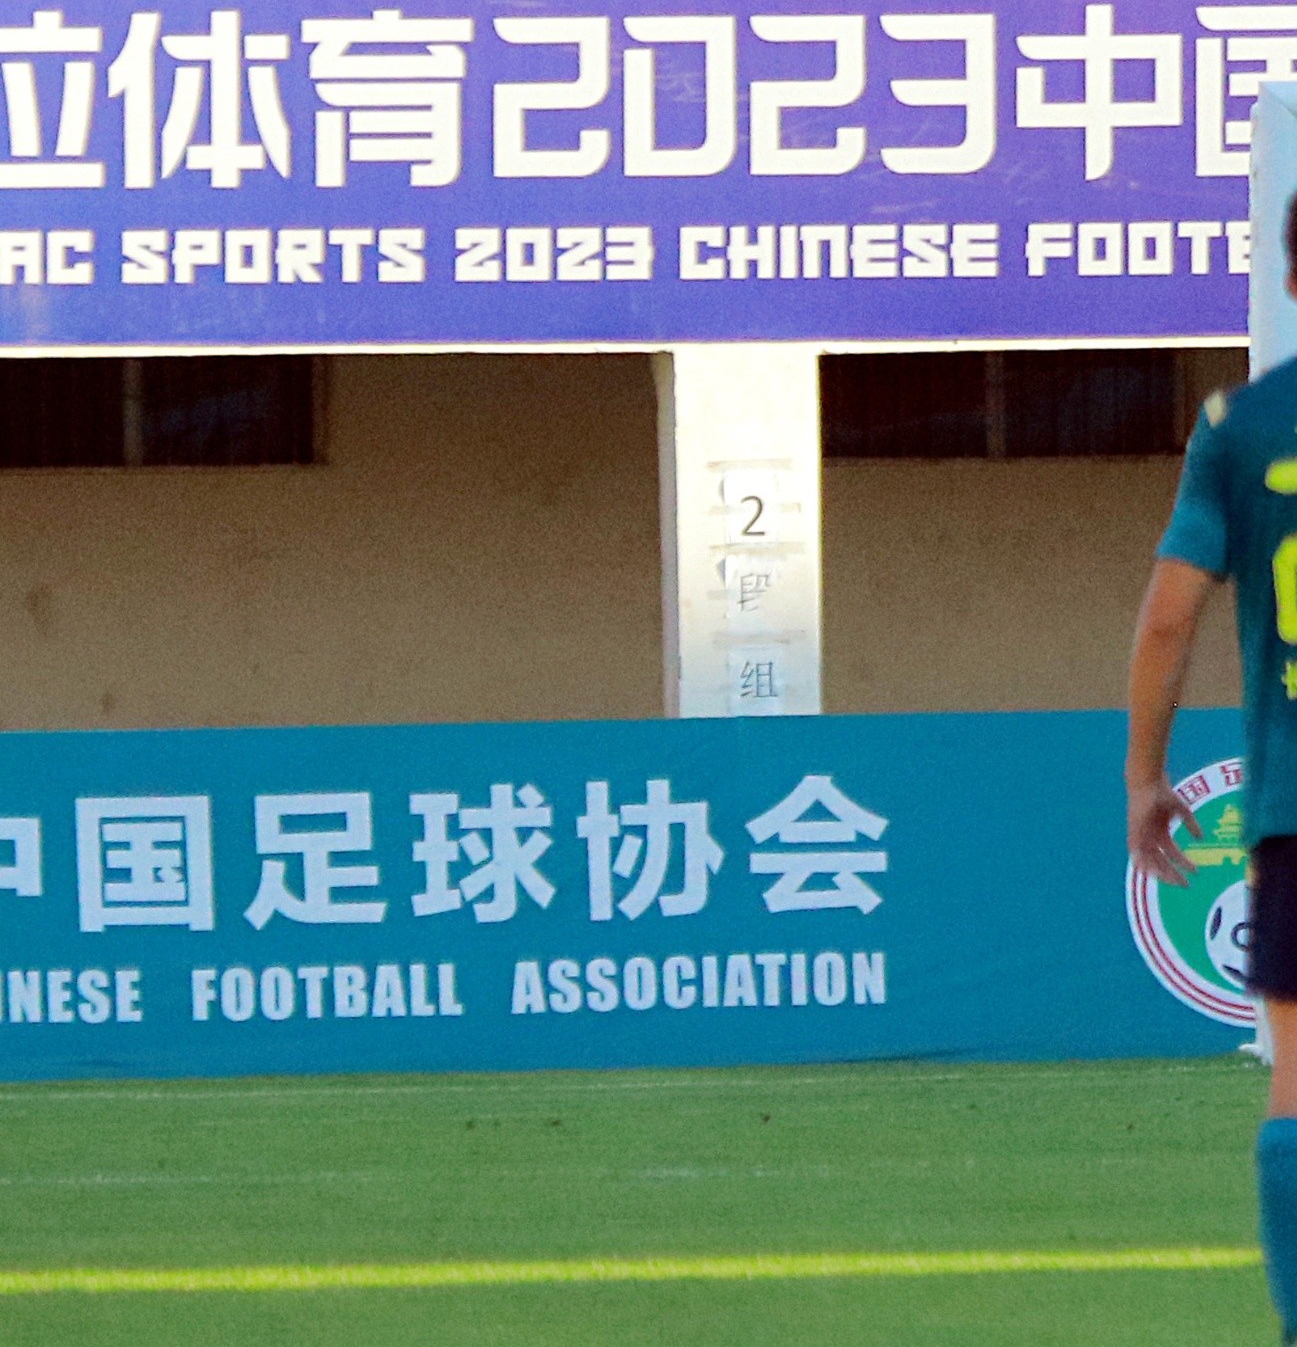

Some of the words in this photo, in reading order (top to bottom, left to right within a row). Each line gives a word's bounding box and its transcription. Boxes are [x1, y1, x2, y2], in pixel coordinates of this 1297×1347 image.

[121, 228, 425, 283] SPORTS
[455, 226, 653, 282] 2023
[679, 223, 999, 280] CHINESE
[1025, 220, 1250, 276] FOOT
[0, 967, 143, 1024] NESE
[191, 962, 464, 1022] FOOTBALL
[511, 951, 887, 1016] ASSOCIATION
